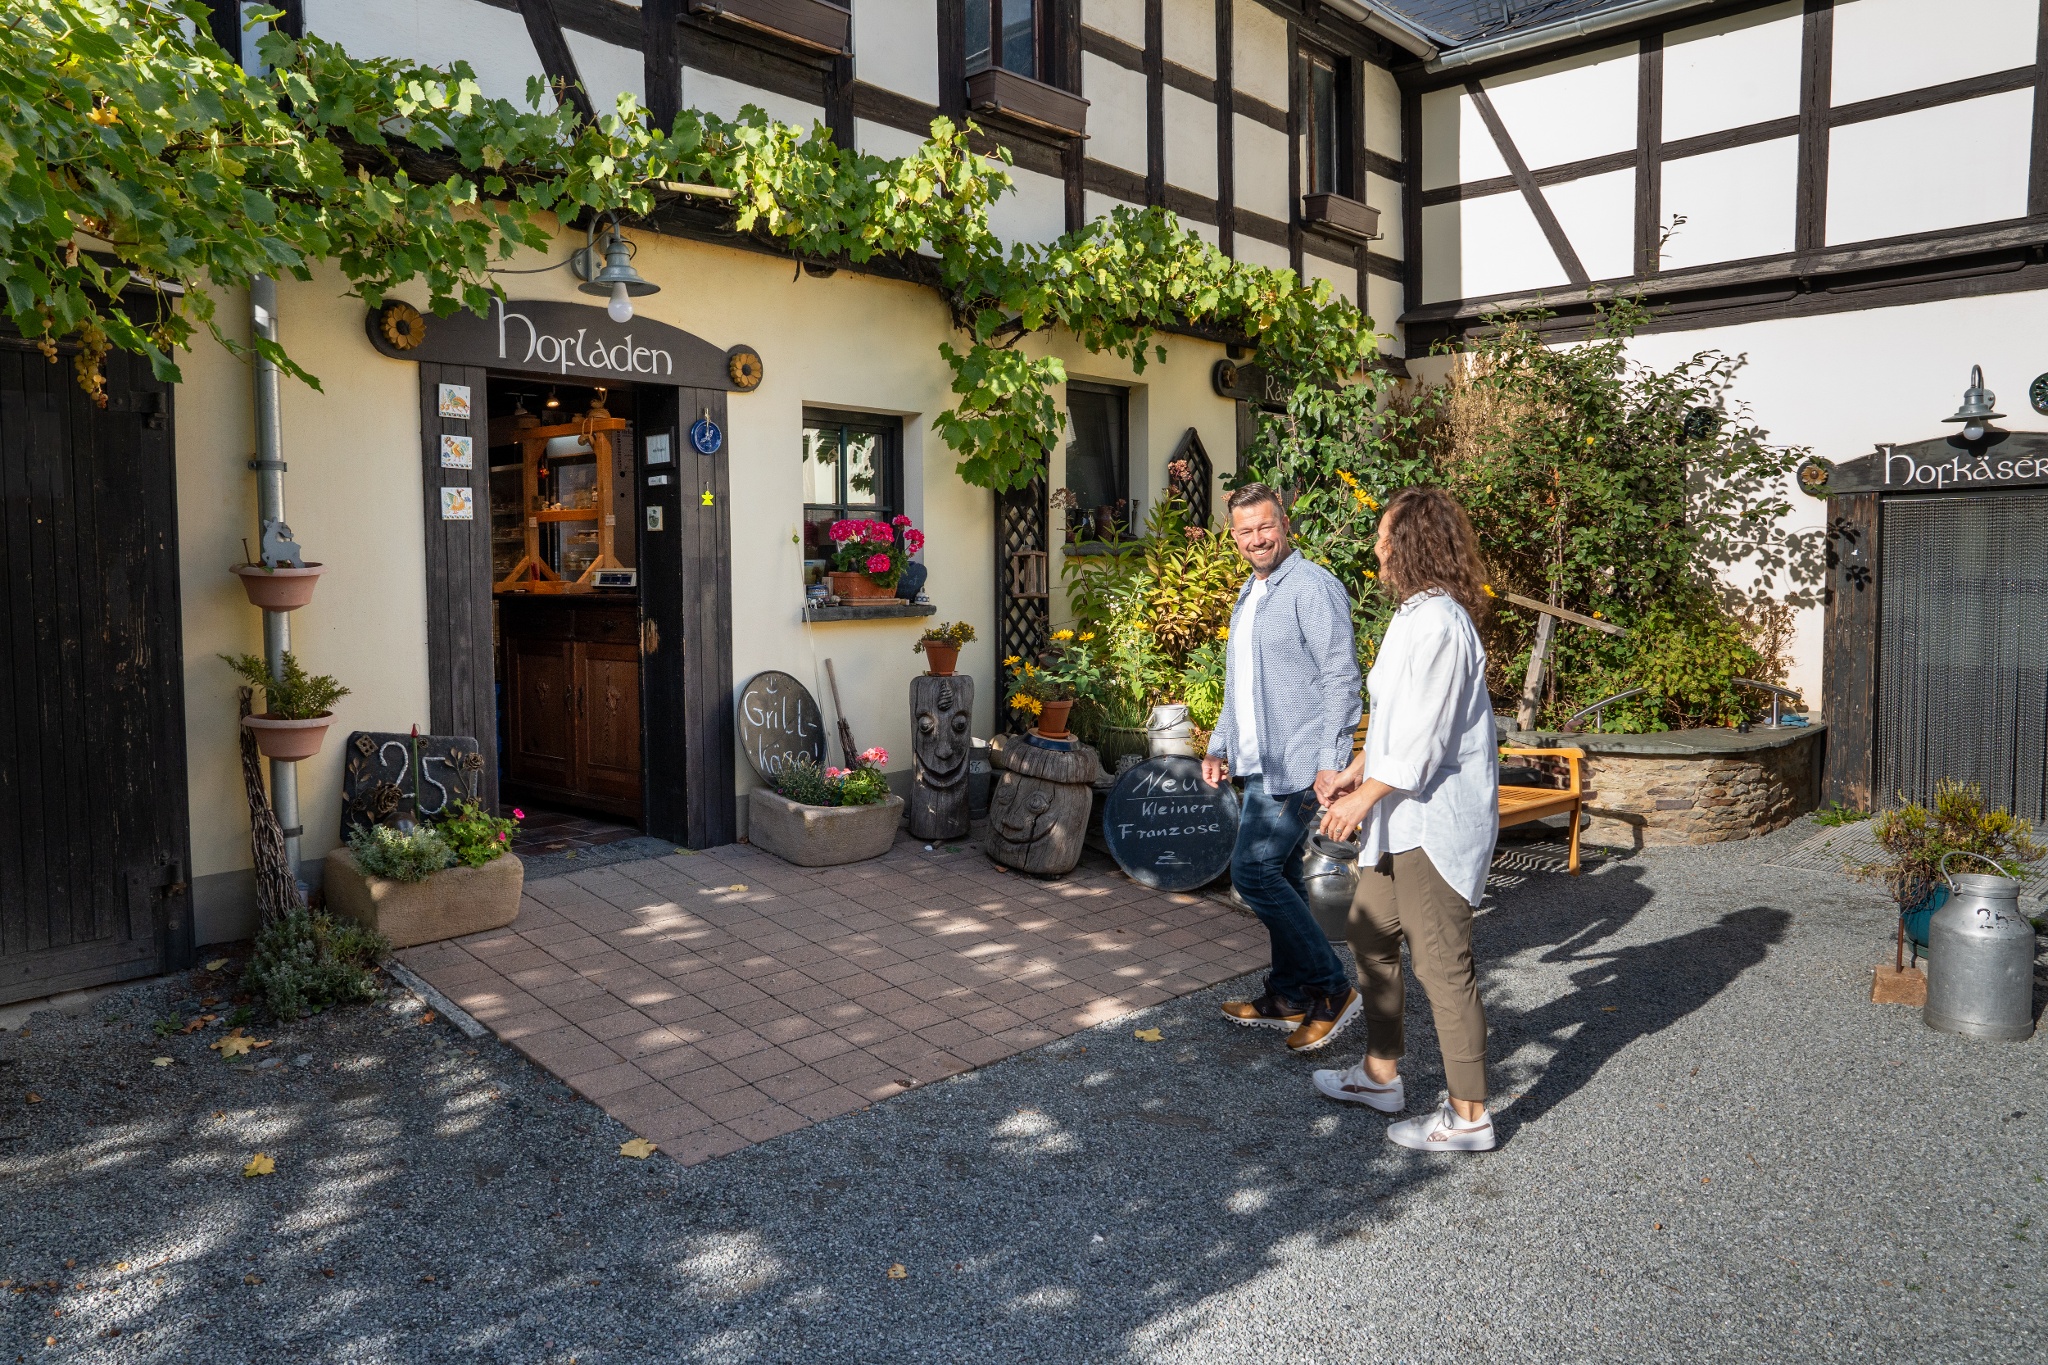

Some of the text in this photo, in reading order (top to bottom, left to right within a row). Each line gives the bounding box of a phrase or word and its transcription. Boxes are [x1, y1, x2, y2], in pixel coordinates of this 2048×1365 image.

[492, 296, 672, 375] Hofladen
[1132, 769, 1199, 796] Neu
[1142, 801, 1214, 817] Kleiner
[1118, 823, 1221, 840] Franzose
